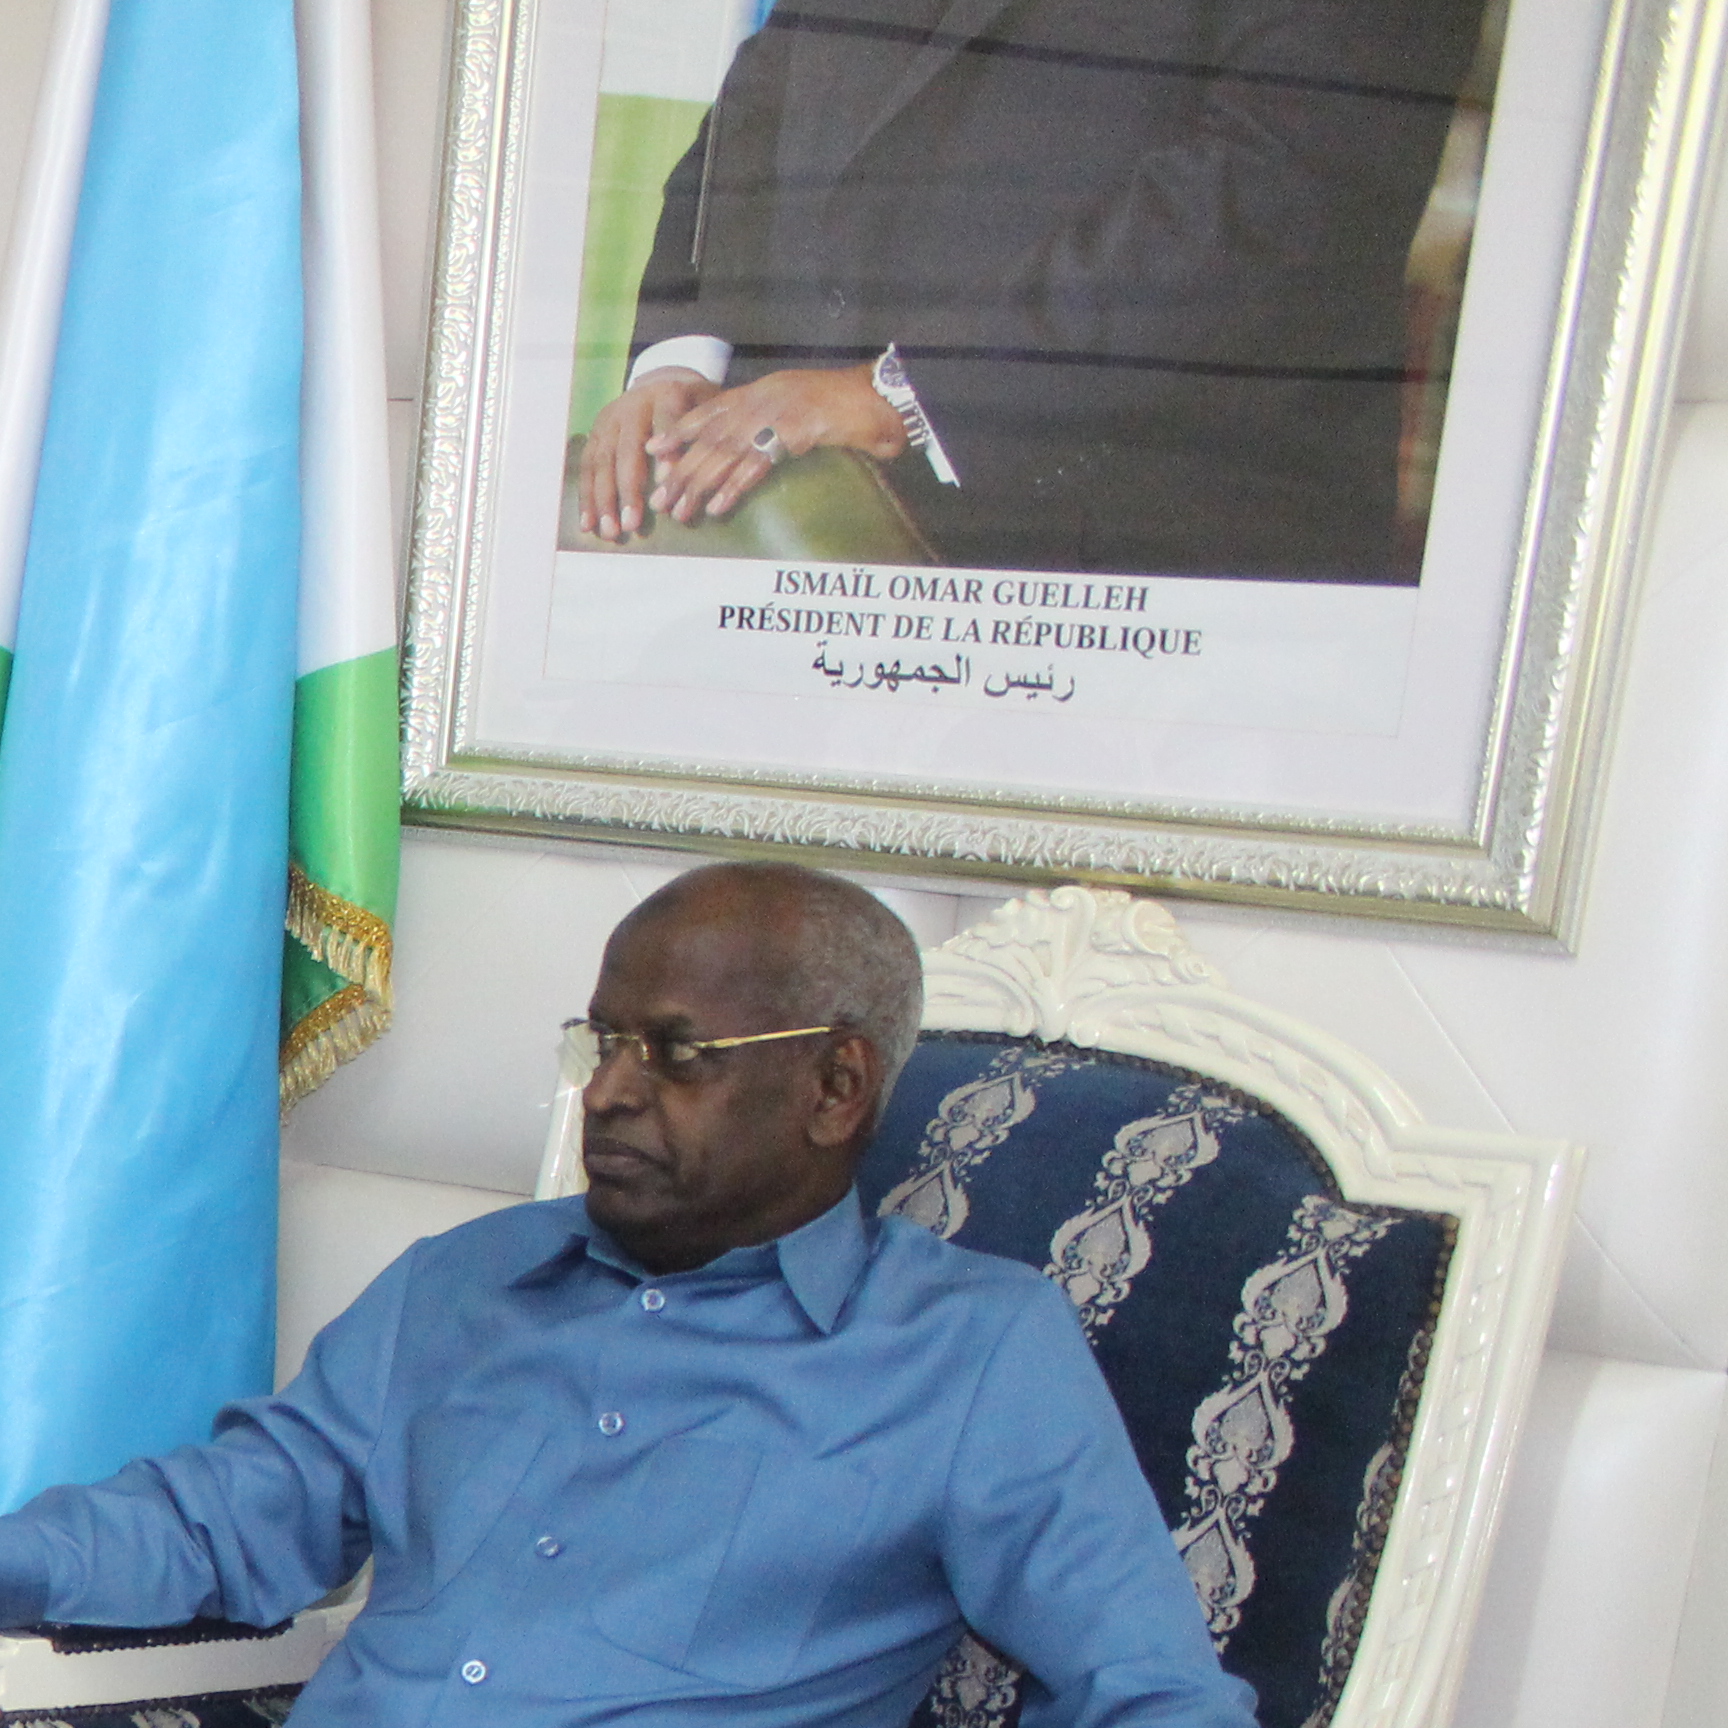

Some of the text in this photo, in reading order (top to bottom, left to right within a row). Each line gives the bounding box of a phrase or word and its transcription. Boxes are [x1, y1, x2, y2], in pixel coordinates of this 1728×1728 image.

[773, 569, 1149, 612] ISMAÏL OMAR GUELLEH
[718, 602, 1202, 659] PRÉSIDENT DE LA RÉPUBLIQUE
[812, 640, 1075, 702] رئيس الجمهورية
